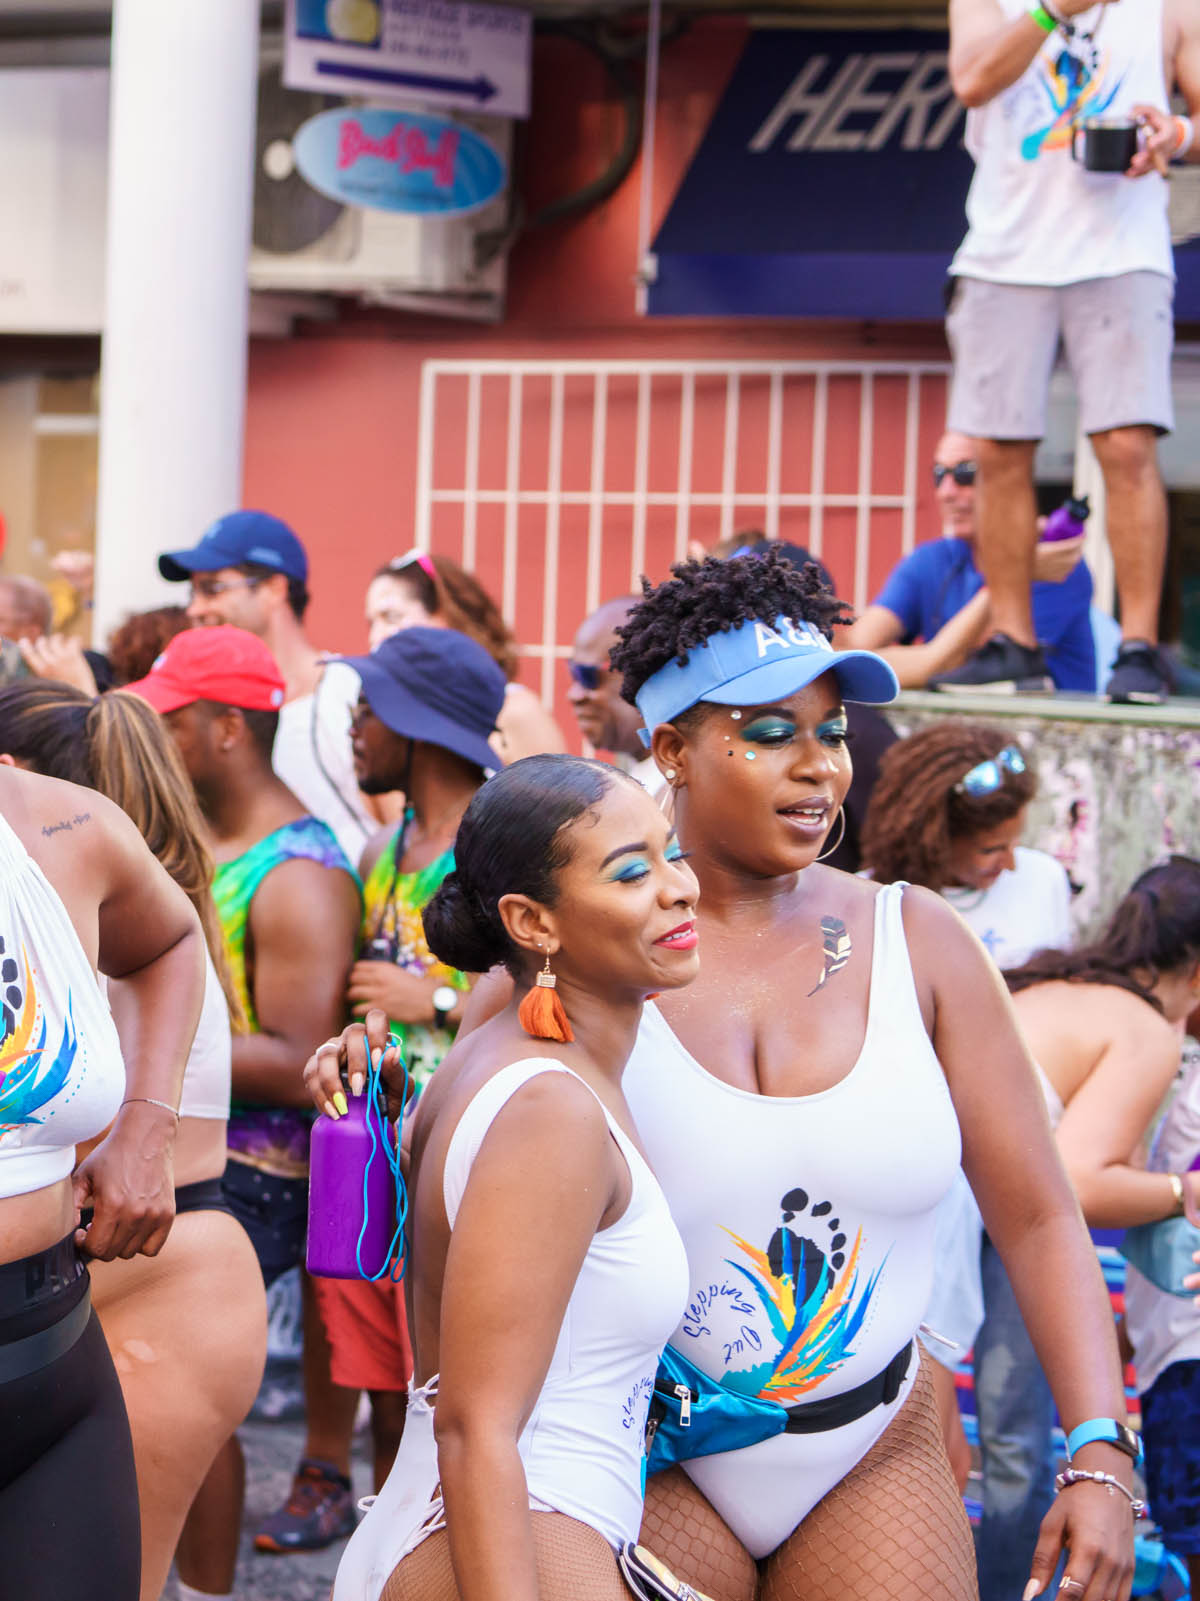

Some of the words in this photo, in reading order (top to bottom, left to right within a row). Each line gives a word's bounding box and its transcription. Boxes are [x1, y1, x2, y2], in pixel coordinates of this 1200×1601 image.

[749, 52, 965, 151] HER
[754, 616, 834, 658] A&
[682, 1280, 757, 1338] Stepping
[722, 1325, 762, 1365] Out
